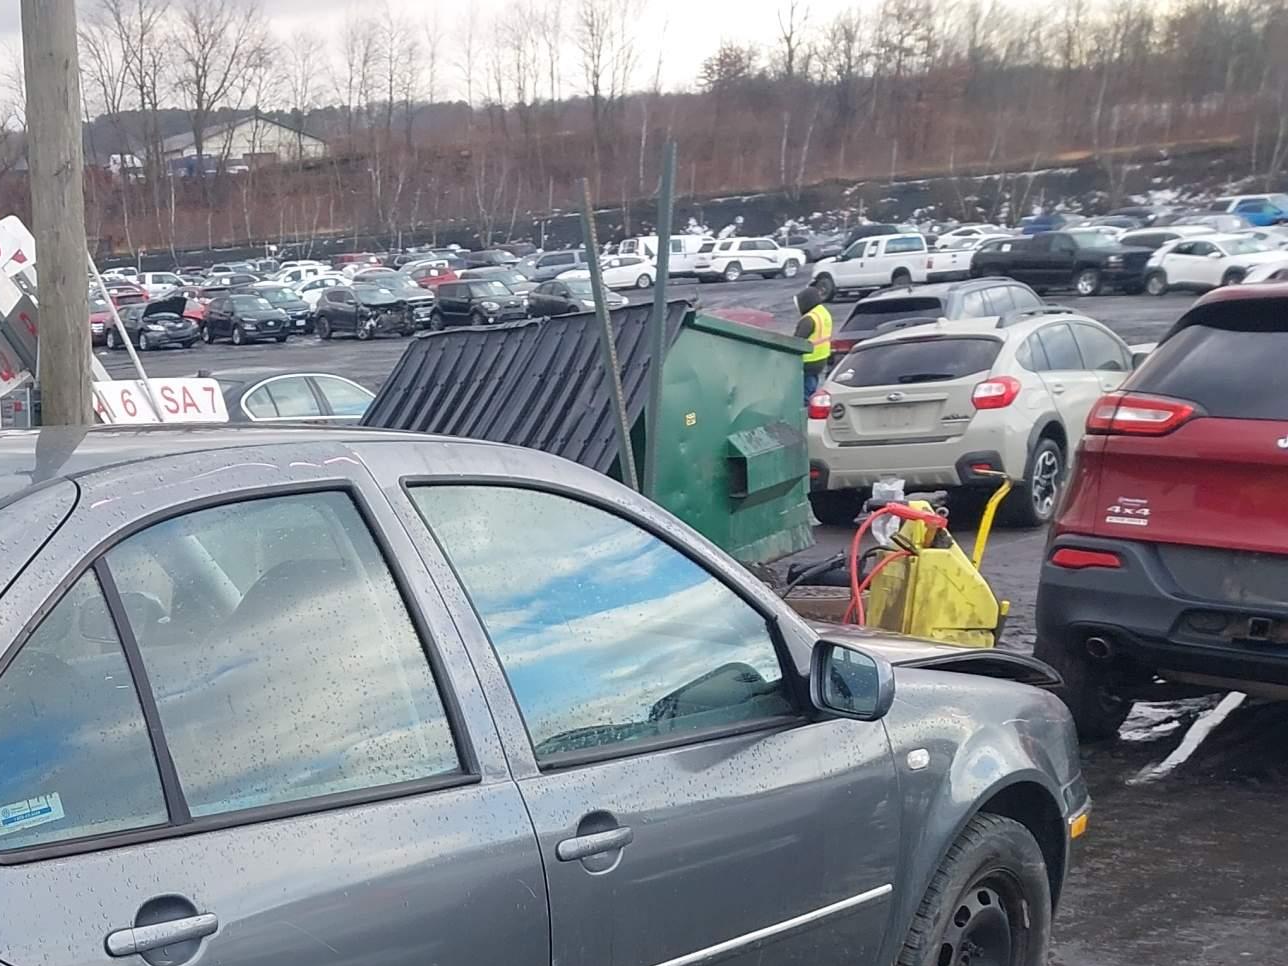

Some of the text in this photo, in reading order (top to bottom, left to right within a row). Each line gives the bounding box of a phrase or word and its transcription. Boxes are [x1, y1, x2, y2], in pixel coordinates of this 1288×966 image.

[121, 389, 137, 417] 6
[160, 386, 216, 414] SA 7
